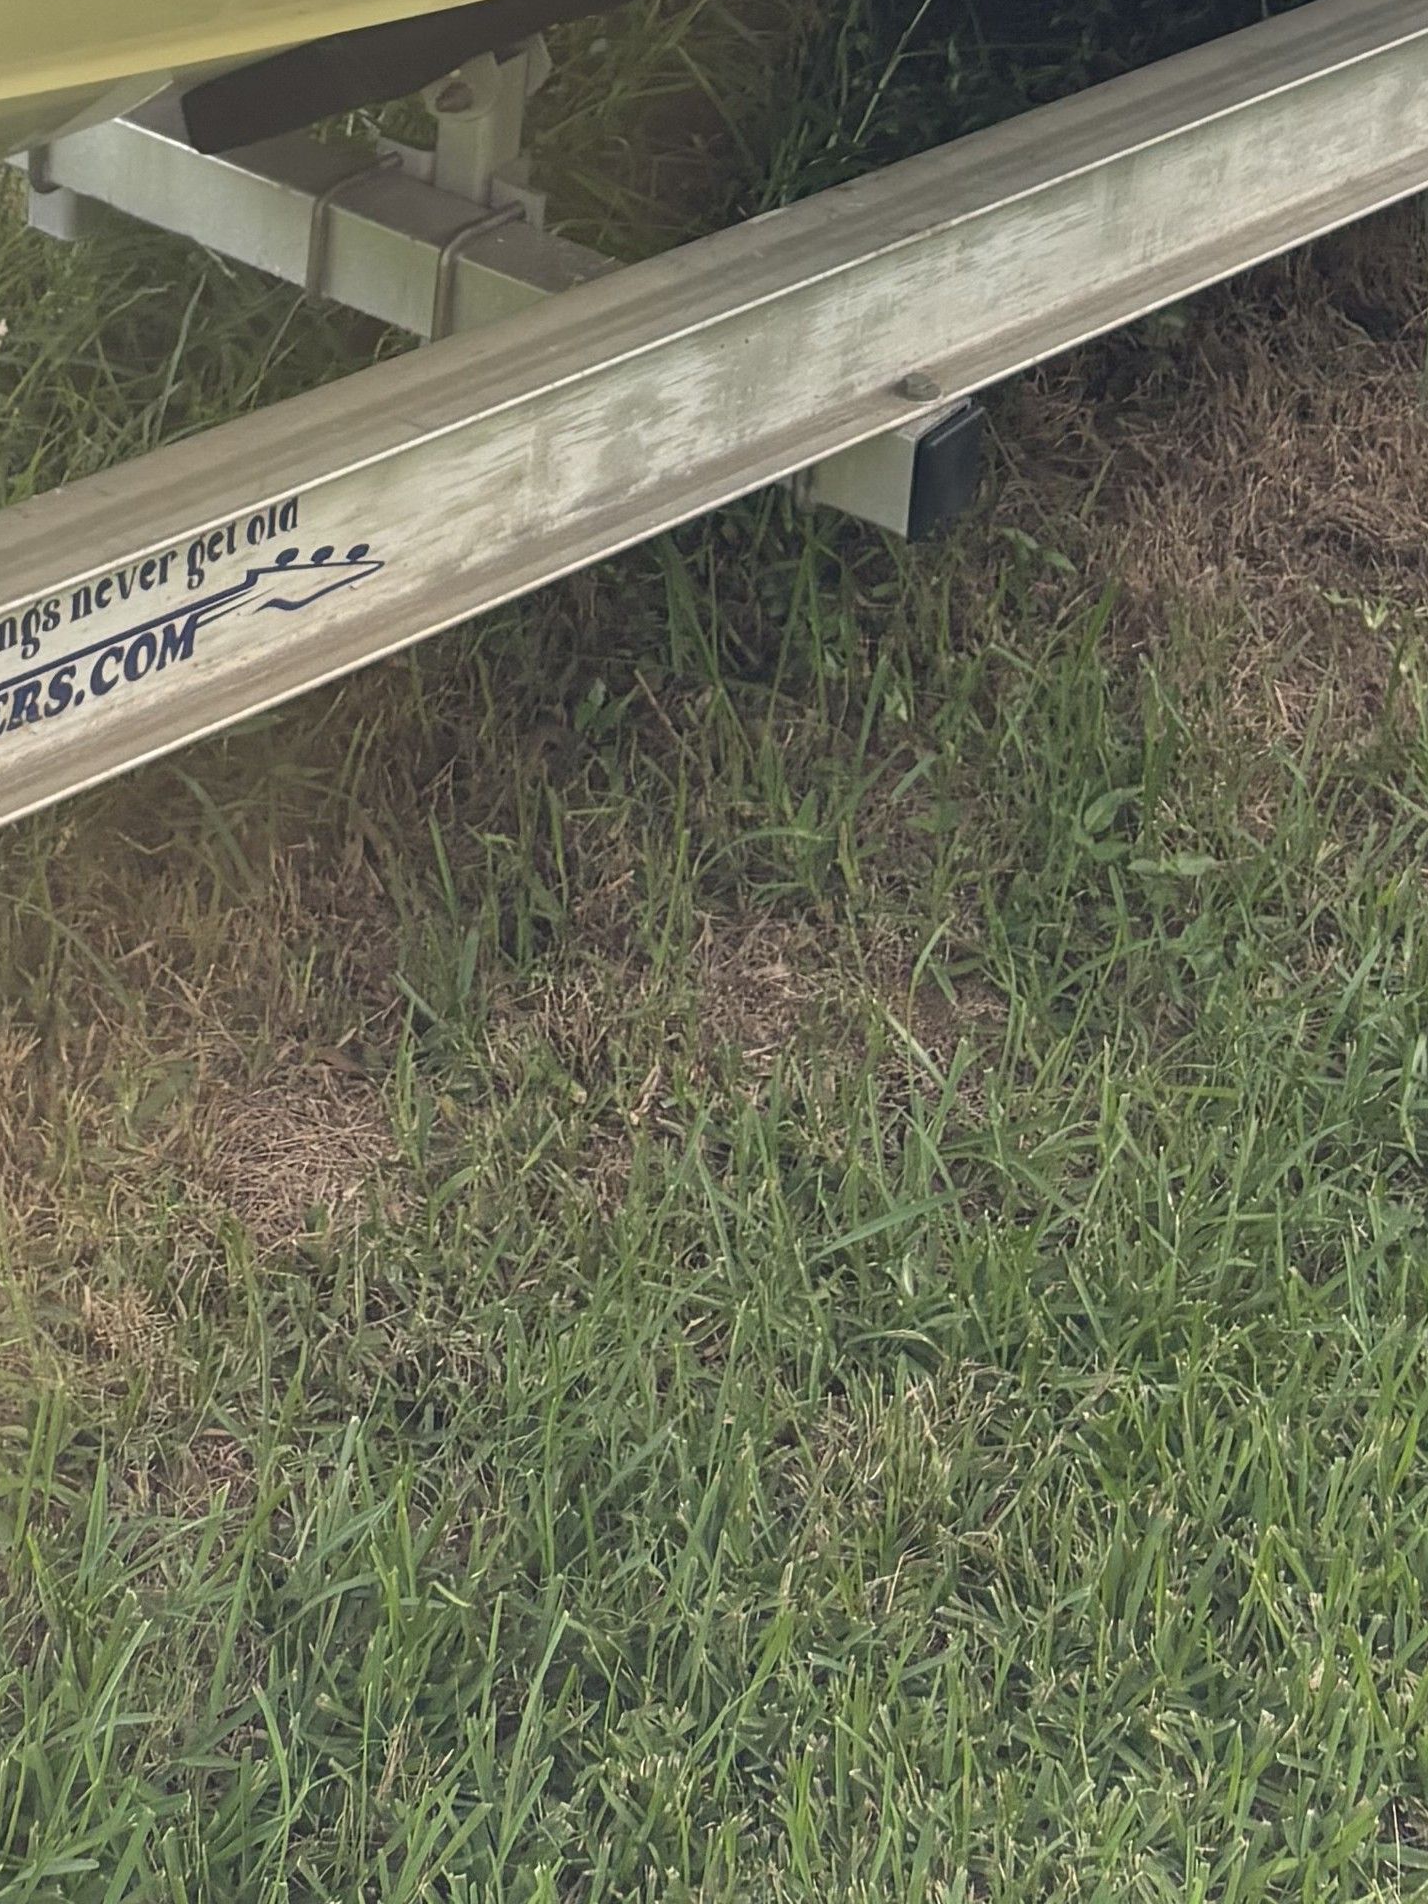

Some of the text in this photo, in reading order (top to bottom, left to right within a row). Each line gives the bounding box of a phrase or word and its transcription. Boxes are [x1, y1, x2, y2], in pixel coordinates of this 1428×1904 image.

[71, 550, 178, 623] never
[186, 528, 237, 589] get
[246, 496, 299, 545] old
